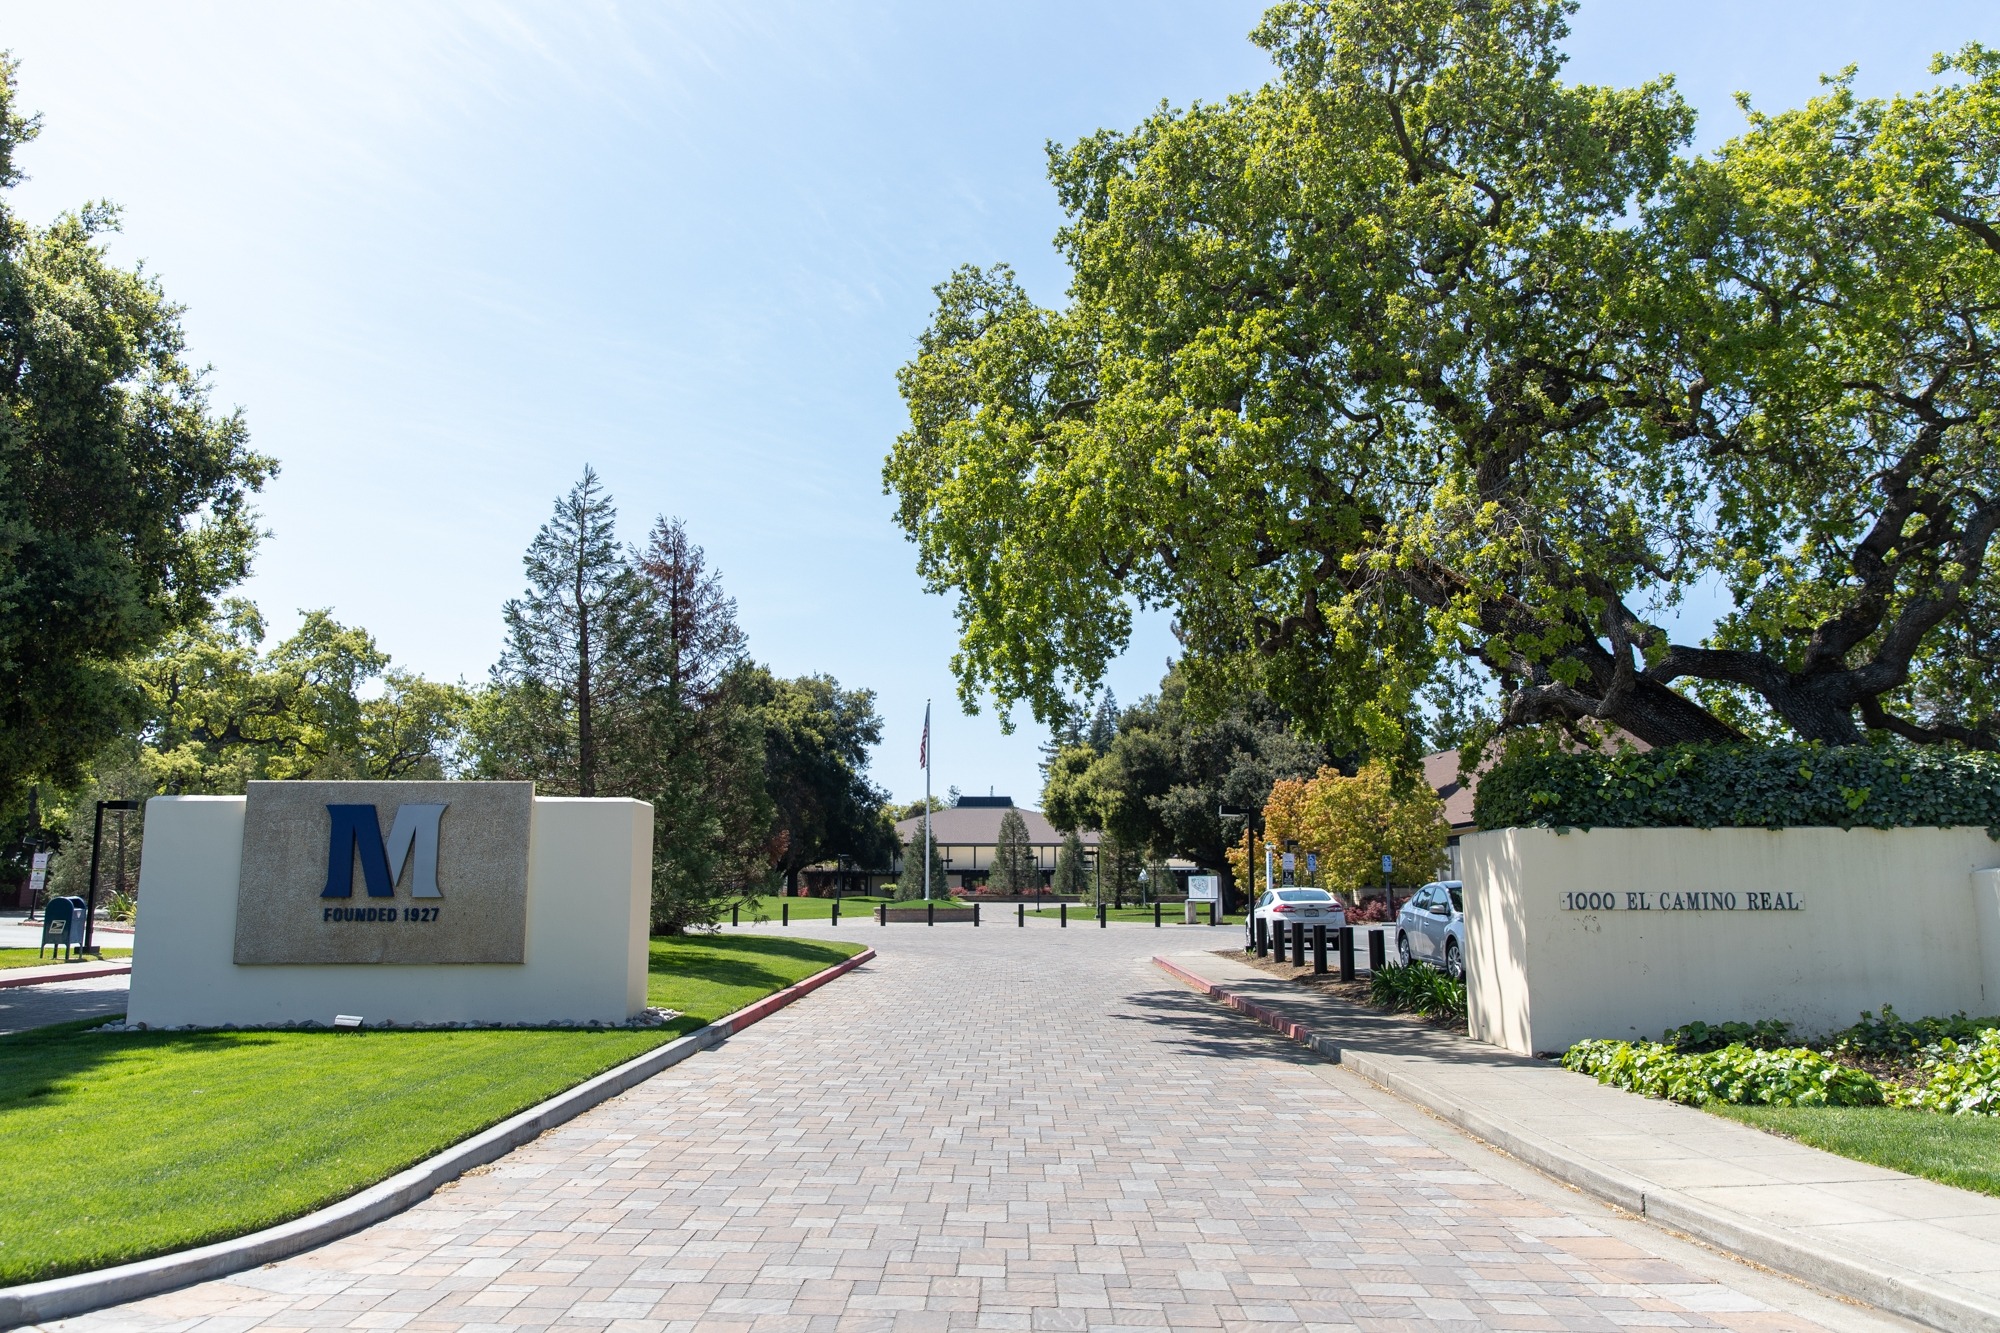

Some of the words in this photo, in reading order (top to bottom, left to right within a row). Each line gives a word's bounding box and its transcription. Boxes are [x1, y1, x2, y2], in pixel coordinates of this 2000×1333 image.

[319, 804, 450, 898] M
[1566, 892, 1616, 911] 1000
[1626, 892, 1650, 911] EL
[1659, 892, 1737, 911] CAMINO
[1746, 892, 1800, 911] REAL
[323, 907, 398, 922] FOUNDED
[403, 907, 440, 922] 1927
